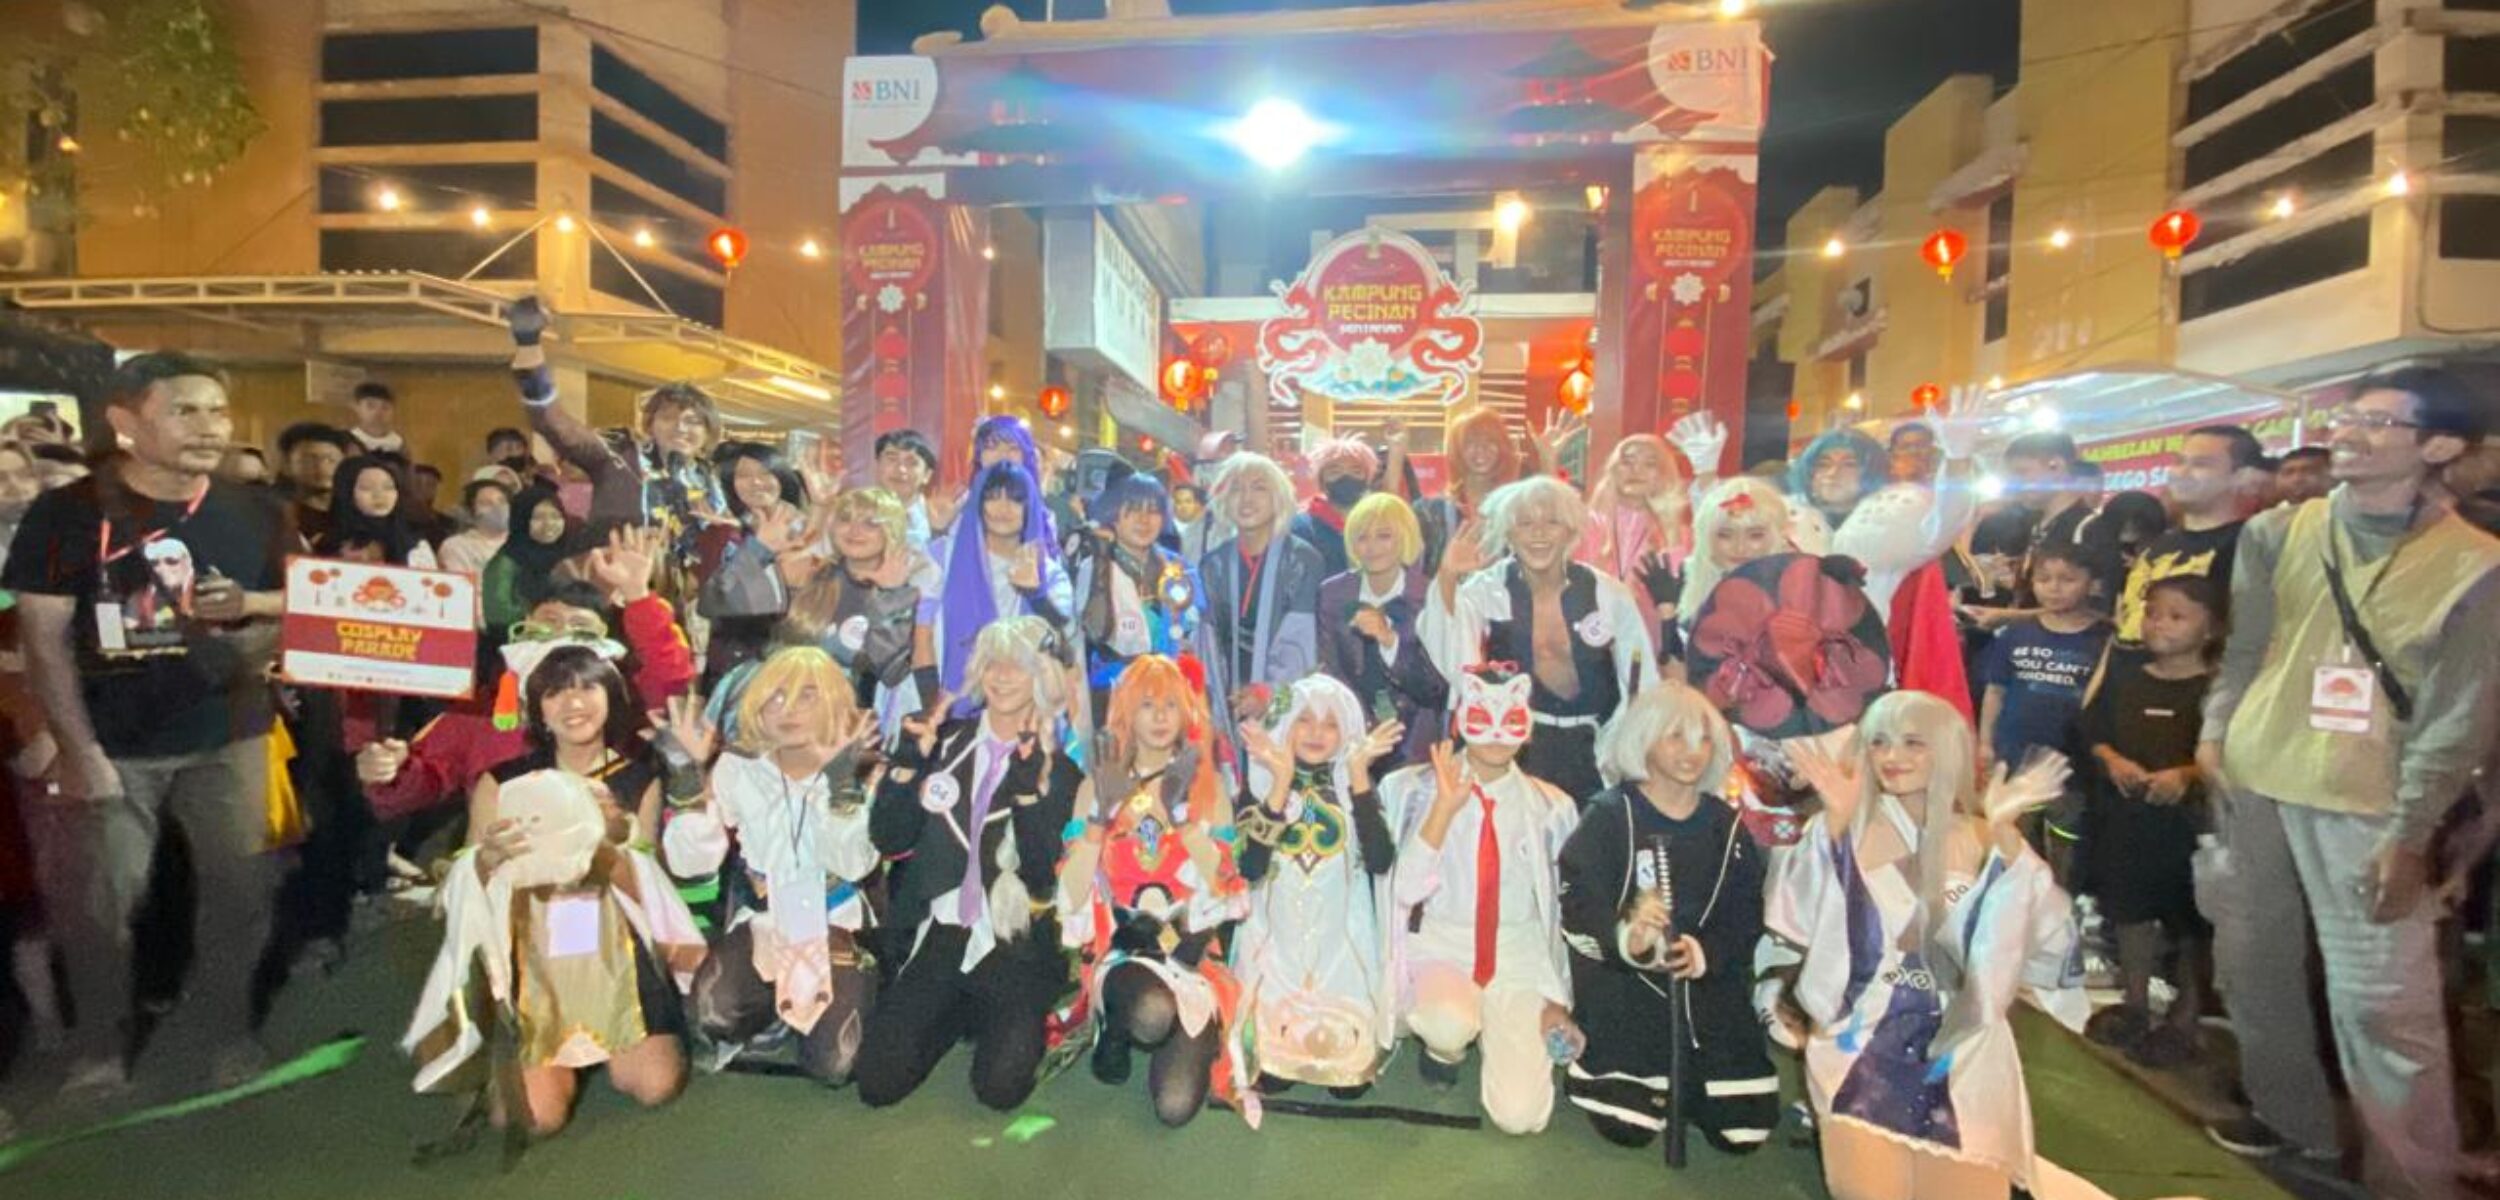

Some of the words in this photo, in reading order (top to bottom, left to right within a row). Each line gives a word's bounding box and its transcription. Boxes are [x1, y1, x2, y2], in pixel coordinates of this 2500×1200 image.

[1697, 47, 1747, 71] BNI
[876, 79, 920, 101] BNI
[1323, 283, 1423, 302] KAMPUNG
[1327, 303, 1418, 321] PECINAN
[336, 620, 424, 643] COSPLAY
[341, 638, 418, 662] PARADE
[2031, 646, 2053, 658] SO
